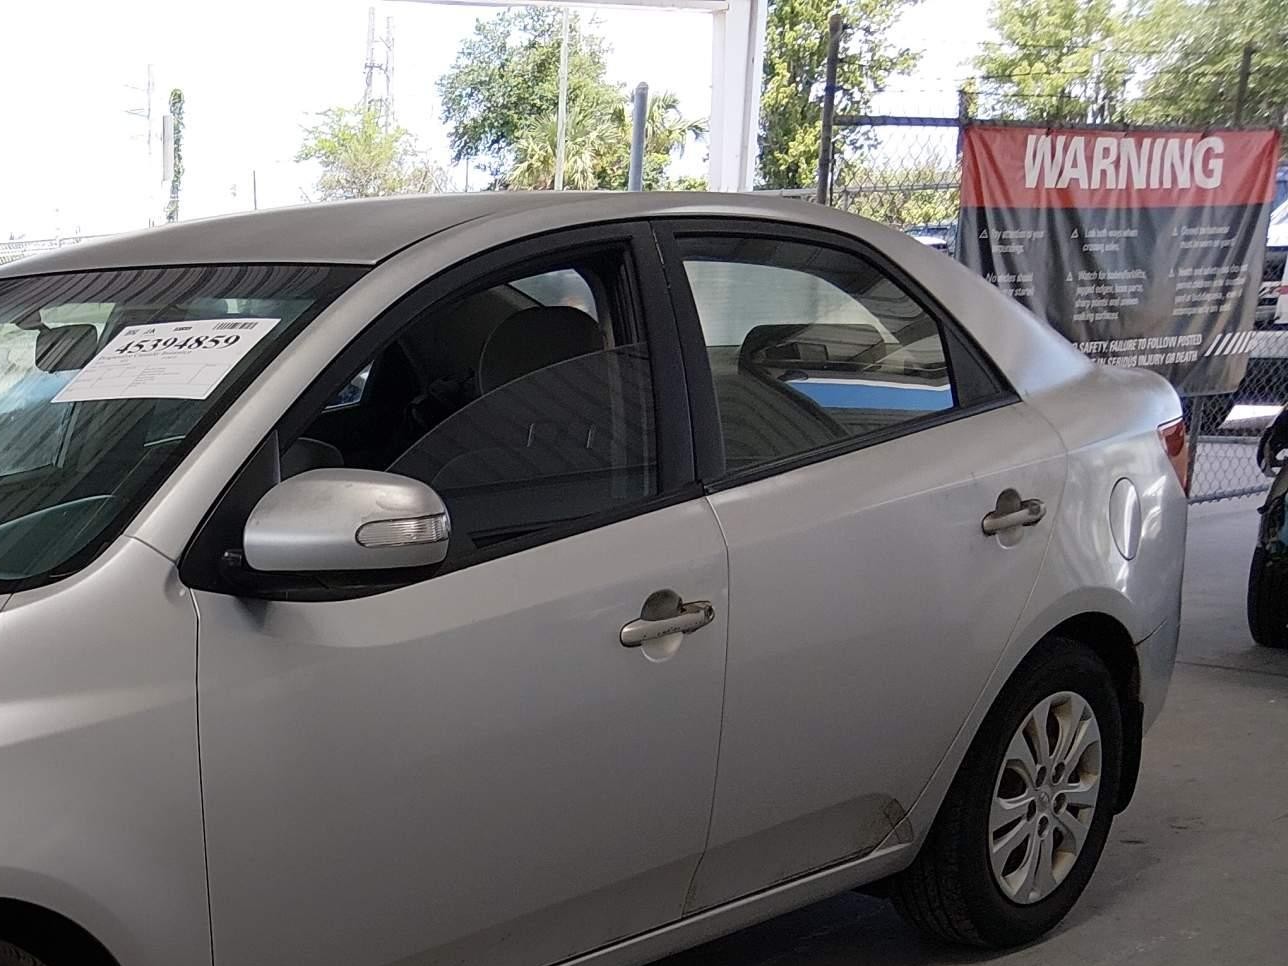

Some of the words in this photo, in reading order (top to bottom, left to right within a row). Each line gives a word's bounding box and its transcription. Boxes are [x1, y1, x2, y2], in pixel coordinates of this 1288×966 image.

[1024, 134, 1225, 190] WARNING
[114, 334, 241, 355] 45394859
[1109, 338, 1137, 352] FAILURE
[1137, 338, 1146, 350] TO
[1147, 336, 1177, 349] FOLLOW
[1177, 334, 1202, 346] POSTED
[1107, 355, 1138, 368] SERIOUS
[1138, 353, 1165, 366] INJURY
[1165, 352, 1176, 364] OR
